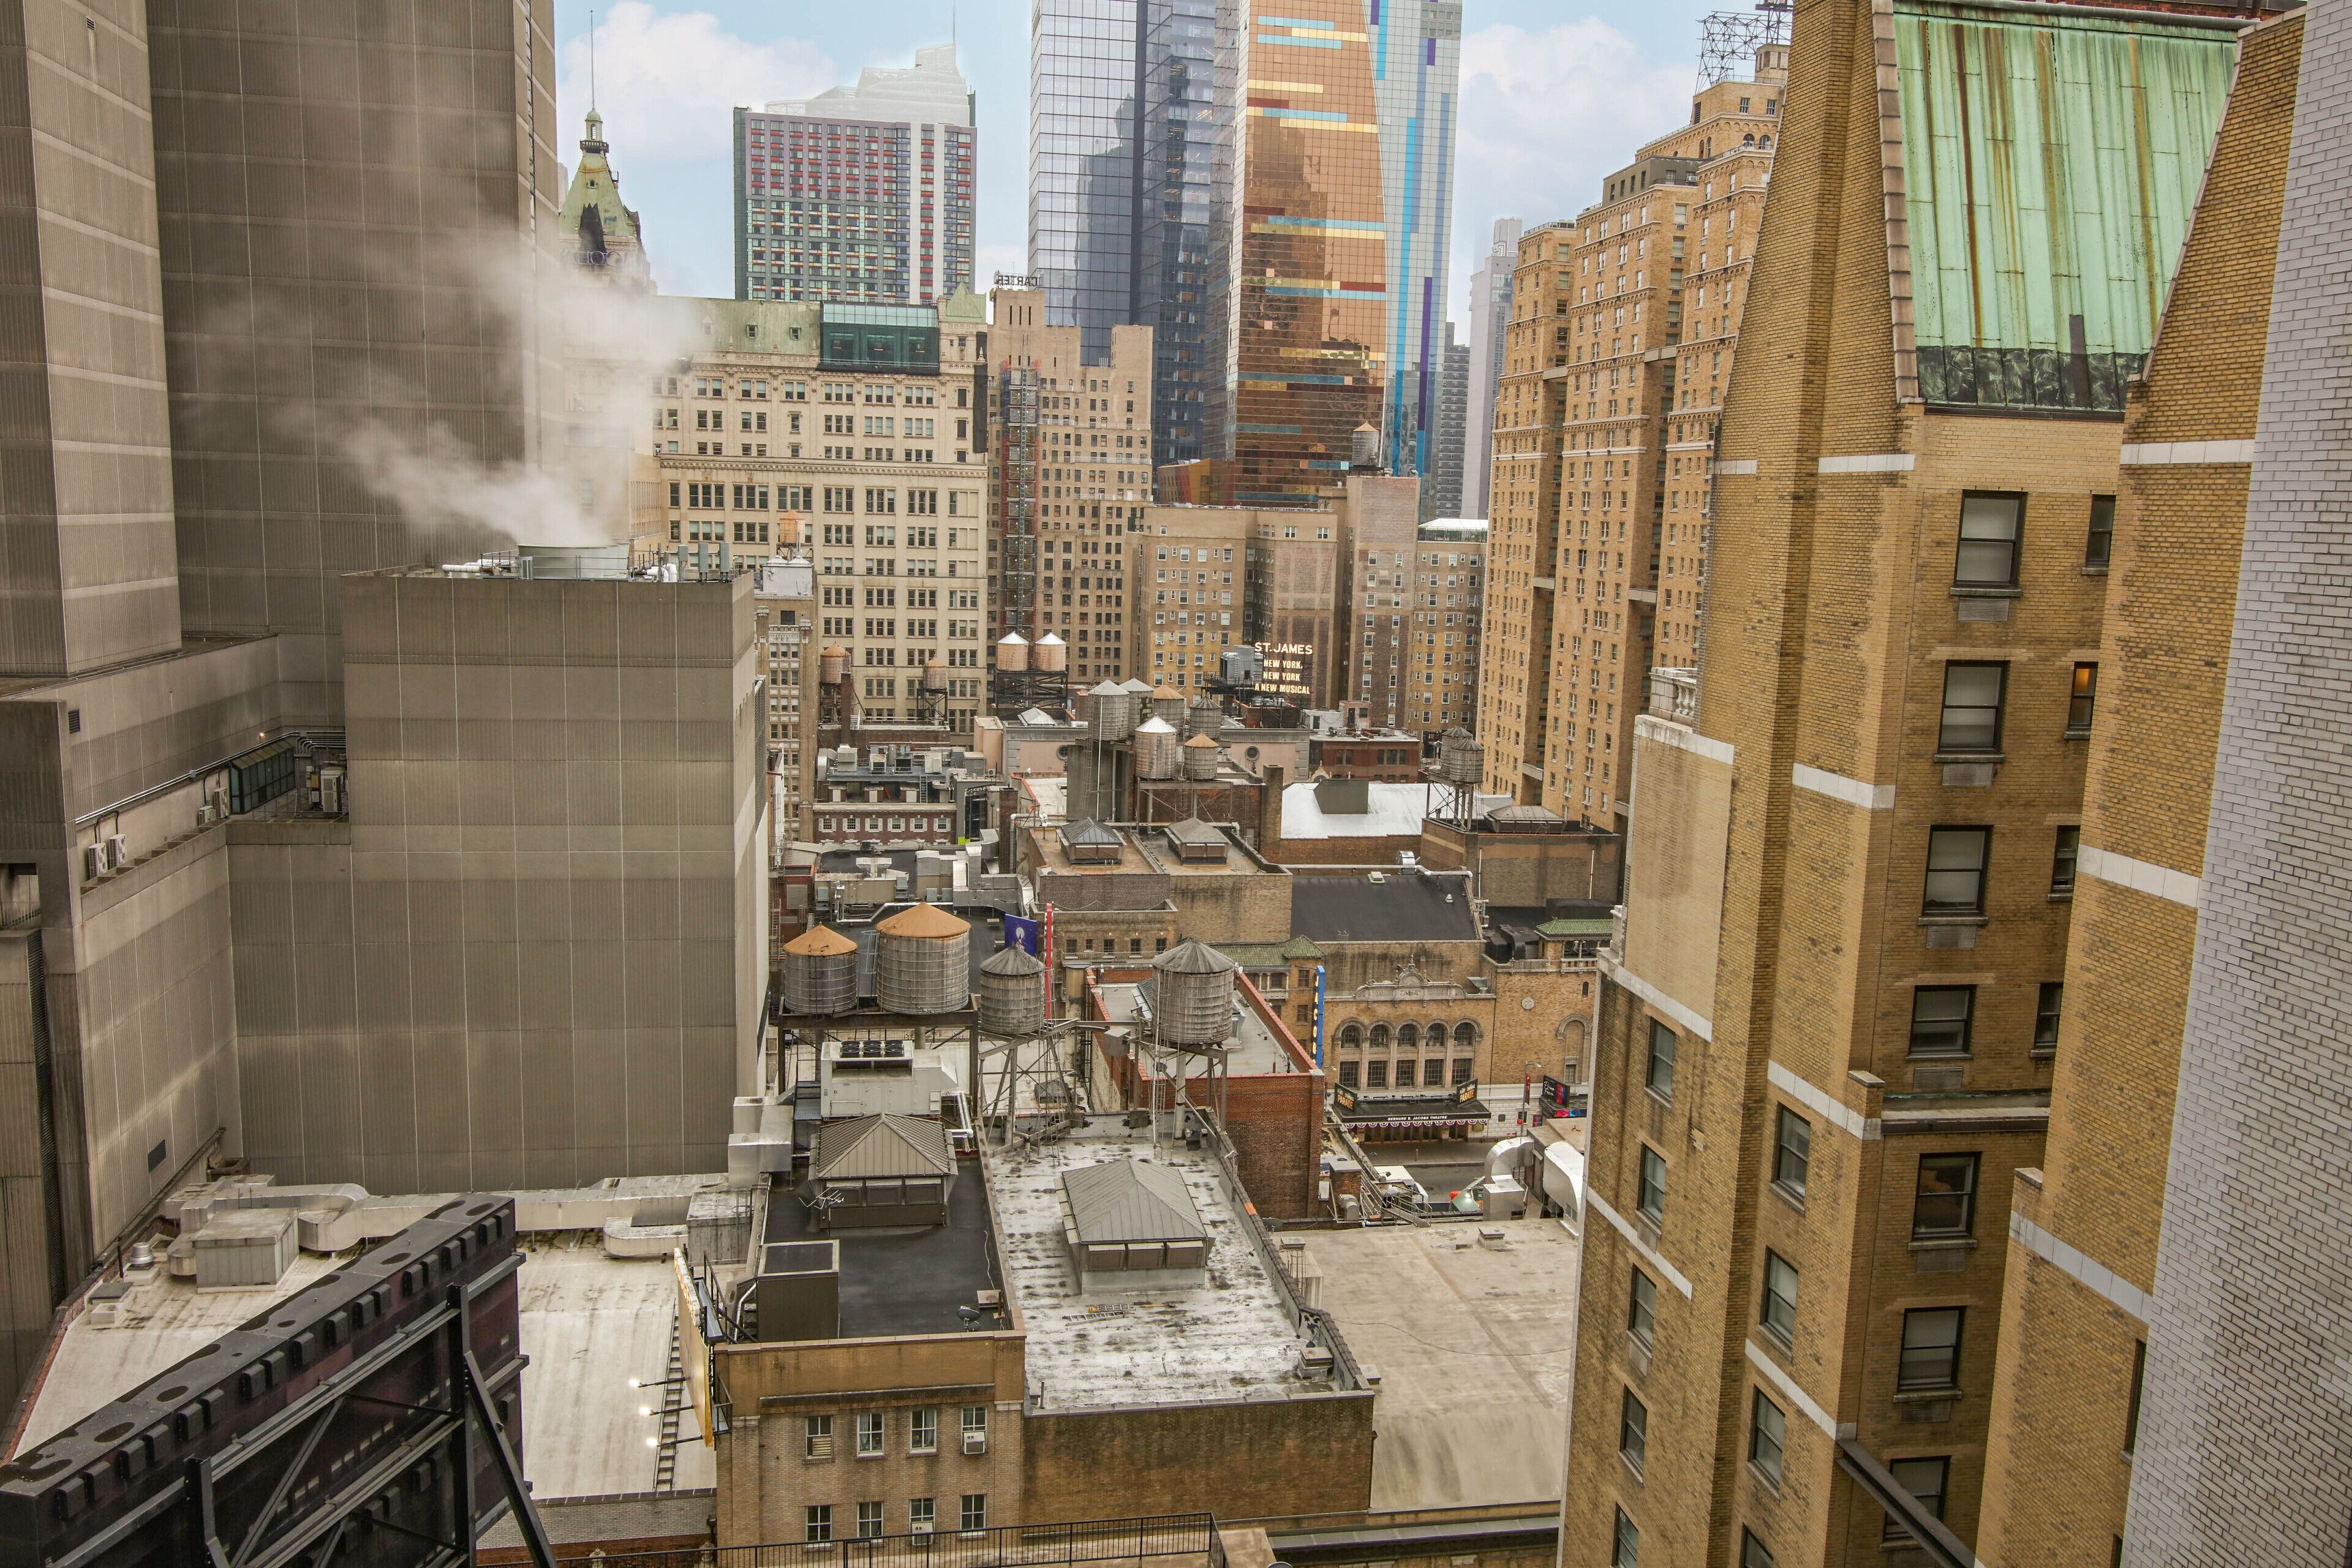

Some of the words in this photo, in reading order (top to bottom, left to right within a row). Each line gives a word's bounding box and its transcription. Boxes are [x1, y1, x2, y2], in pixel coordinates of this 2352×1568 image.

[1273, 643, 1313, 655] JAMES
[1264, 659, 1280, 668] NEW
[1263, 671, 1280, 680] NEW
[1282, 673, 1300, 681] YORK
[1261, 683, 1277, 692] NEW
[1280, 684, 1310, 695] MUSICAL
